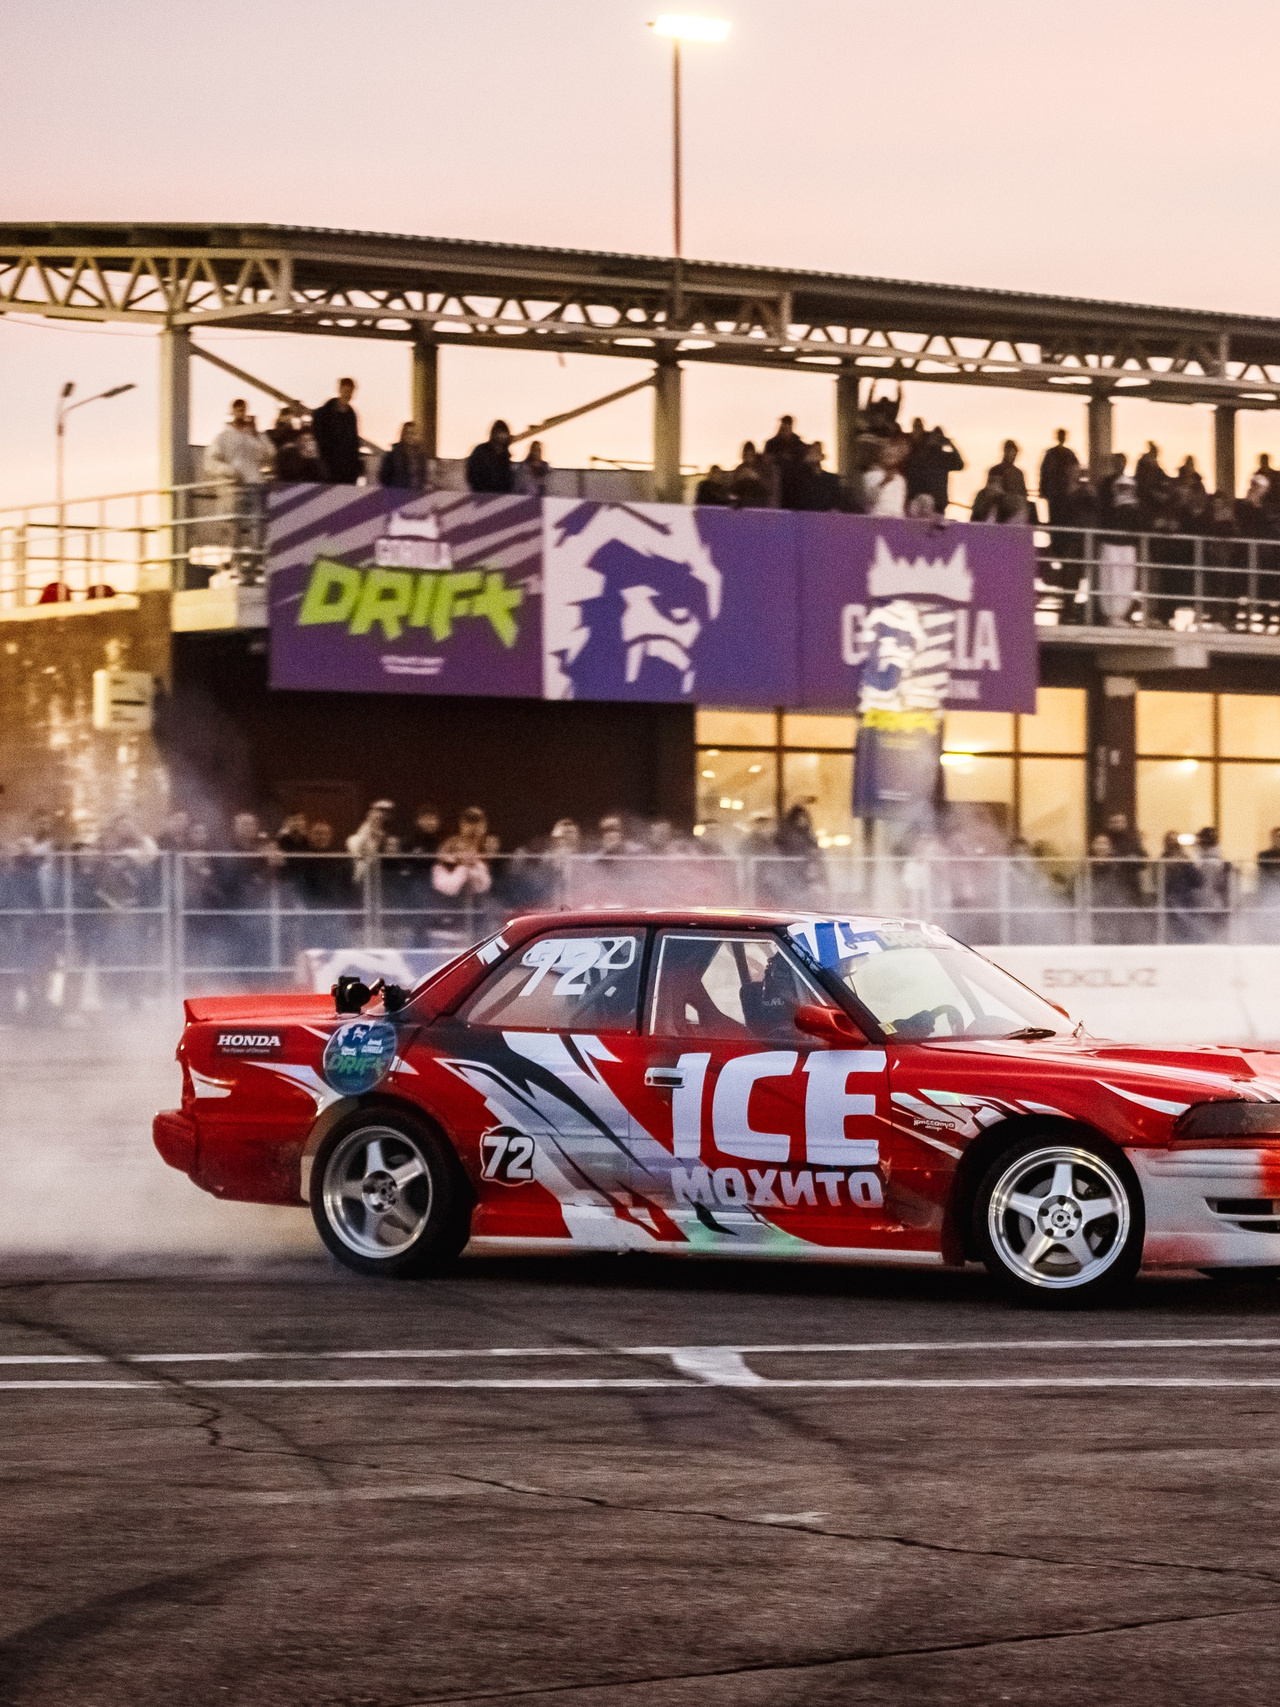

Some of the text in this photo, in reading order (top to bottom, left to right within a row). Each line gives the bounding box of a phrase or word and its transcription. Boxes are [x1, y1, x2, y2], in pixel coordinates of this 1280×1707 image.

[297, 559, 523, 648] DRIFT
[519, 937, 602, 997] 72
[217, 1034, 281, 1047] HONDA
[673, 1050, 887, 1166] ICE
[483, 1135, 533, 1179] 72
[670, 1165, 886, 1208] МОХИТО
